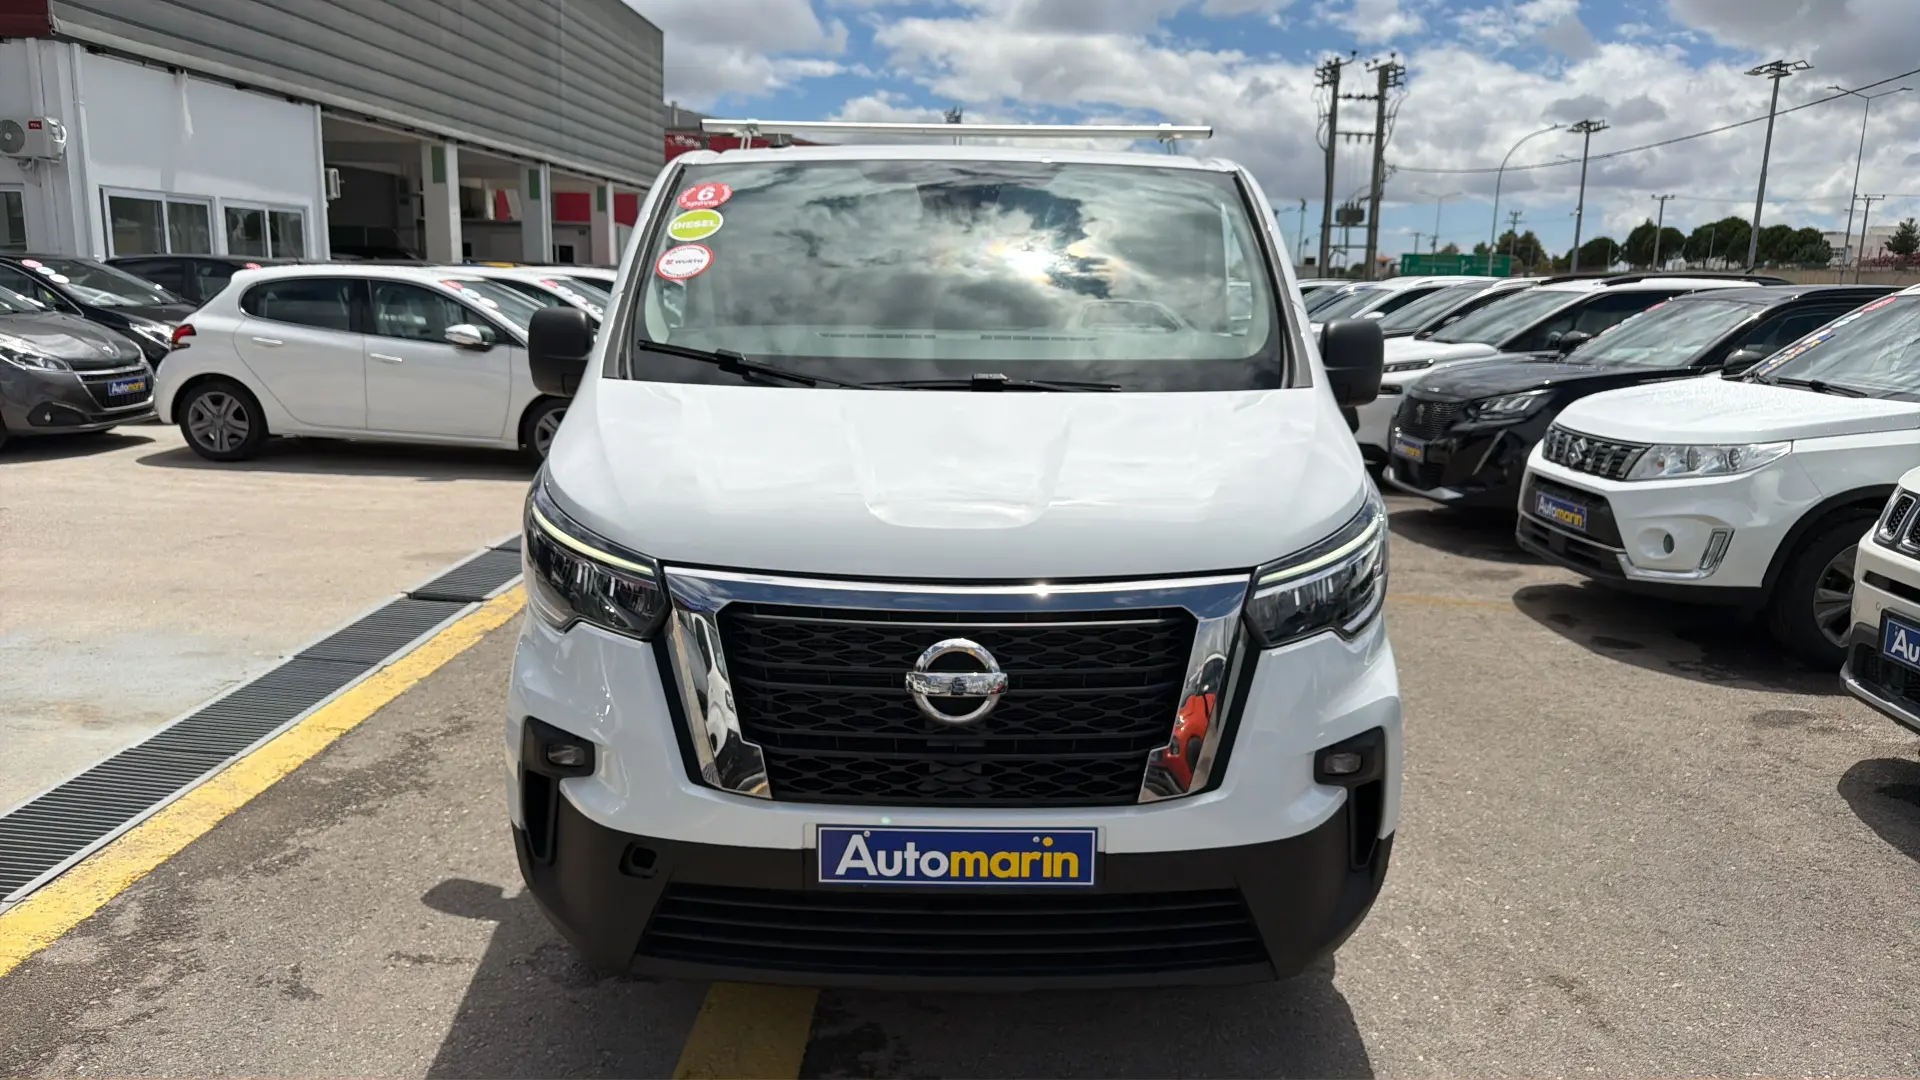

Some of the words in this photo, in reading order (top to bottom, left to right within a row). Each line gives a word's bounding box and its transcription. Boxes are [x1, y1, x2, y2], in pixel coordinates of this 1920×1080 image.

[697, 186, 715, 201] 6
[673, 220, 716, 230] DIESEL
[1538, 496, 1584, 527] Automarin
[834, 833, 1078, 878] Automarin
